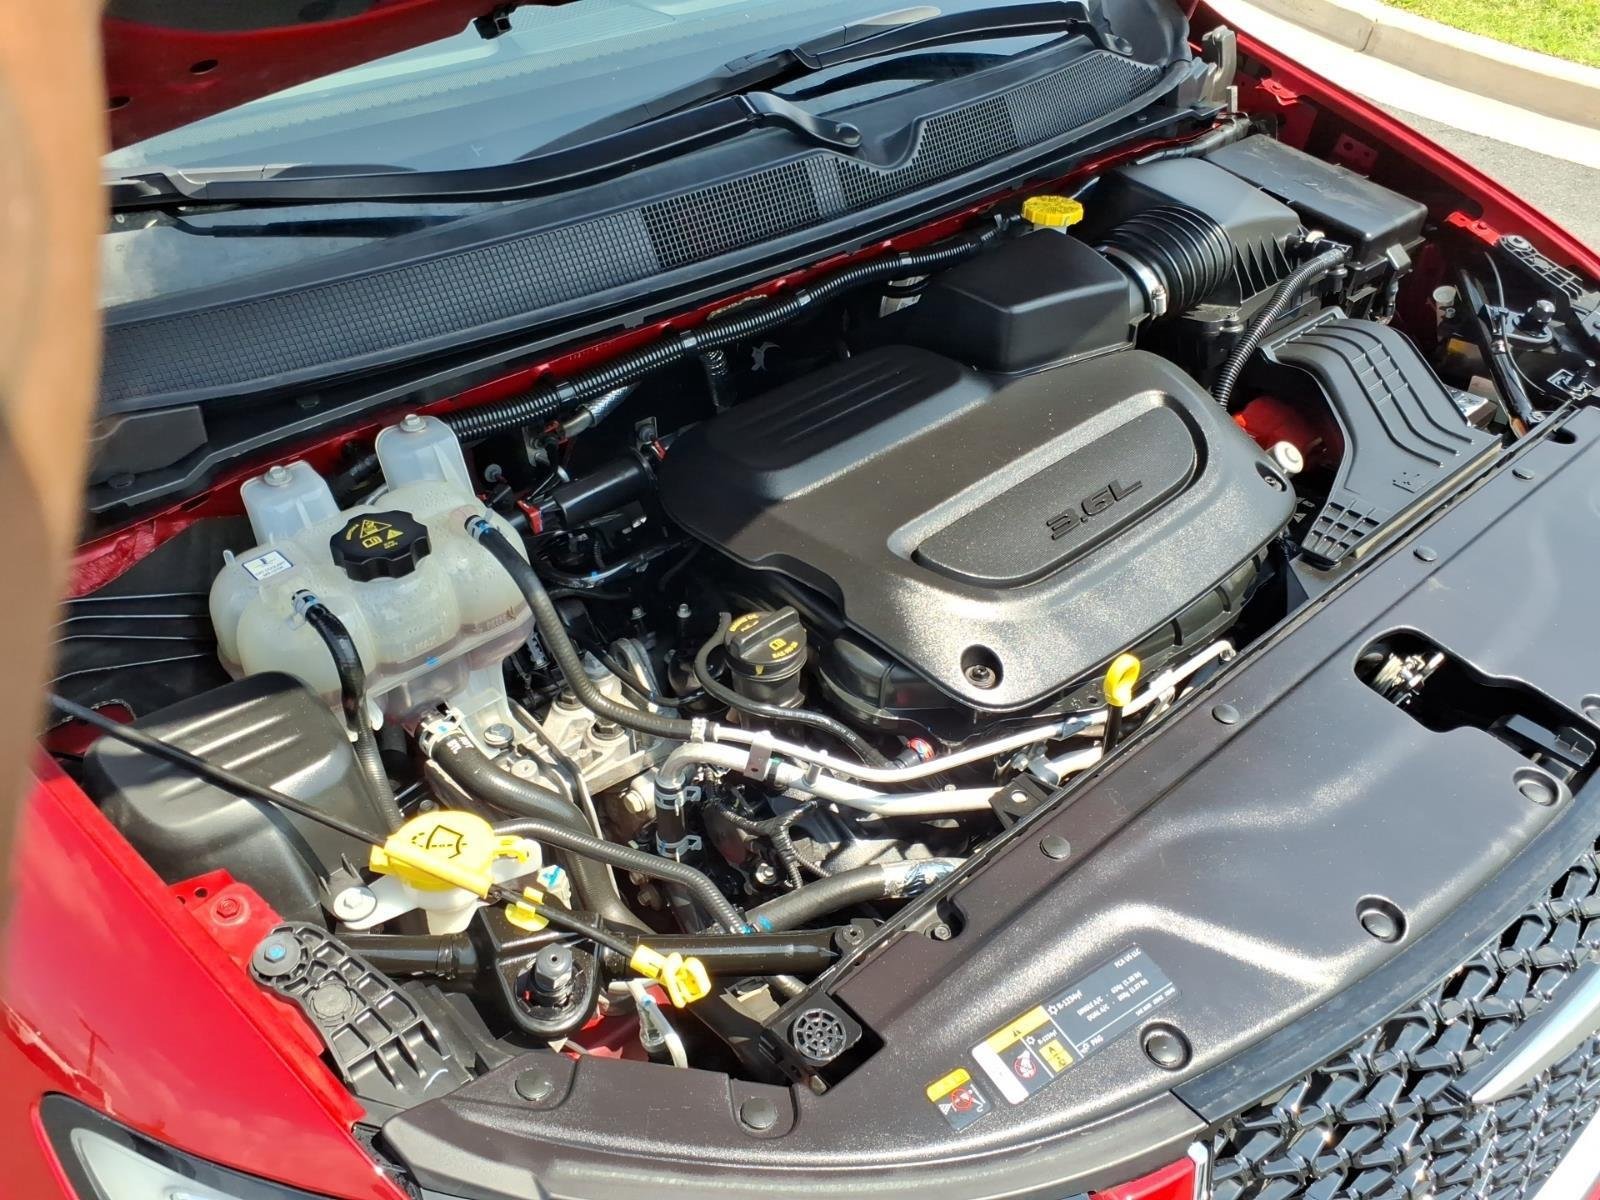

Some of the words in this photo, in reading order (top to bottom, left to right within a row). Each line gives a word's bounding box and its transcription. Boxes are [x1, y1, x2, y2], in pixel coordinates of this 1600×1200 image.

[1046, 480, 1142, 541] 3.6L
[1113, 956, 1126, 969] FCA
[1130, 947, 1142, 958] LLC
